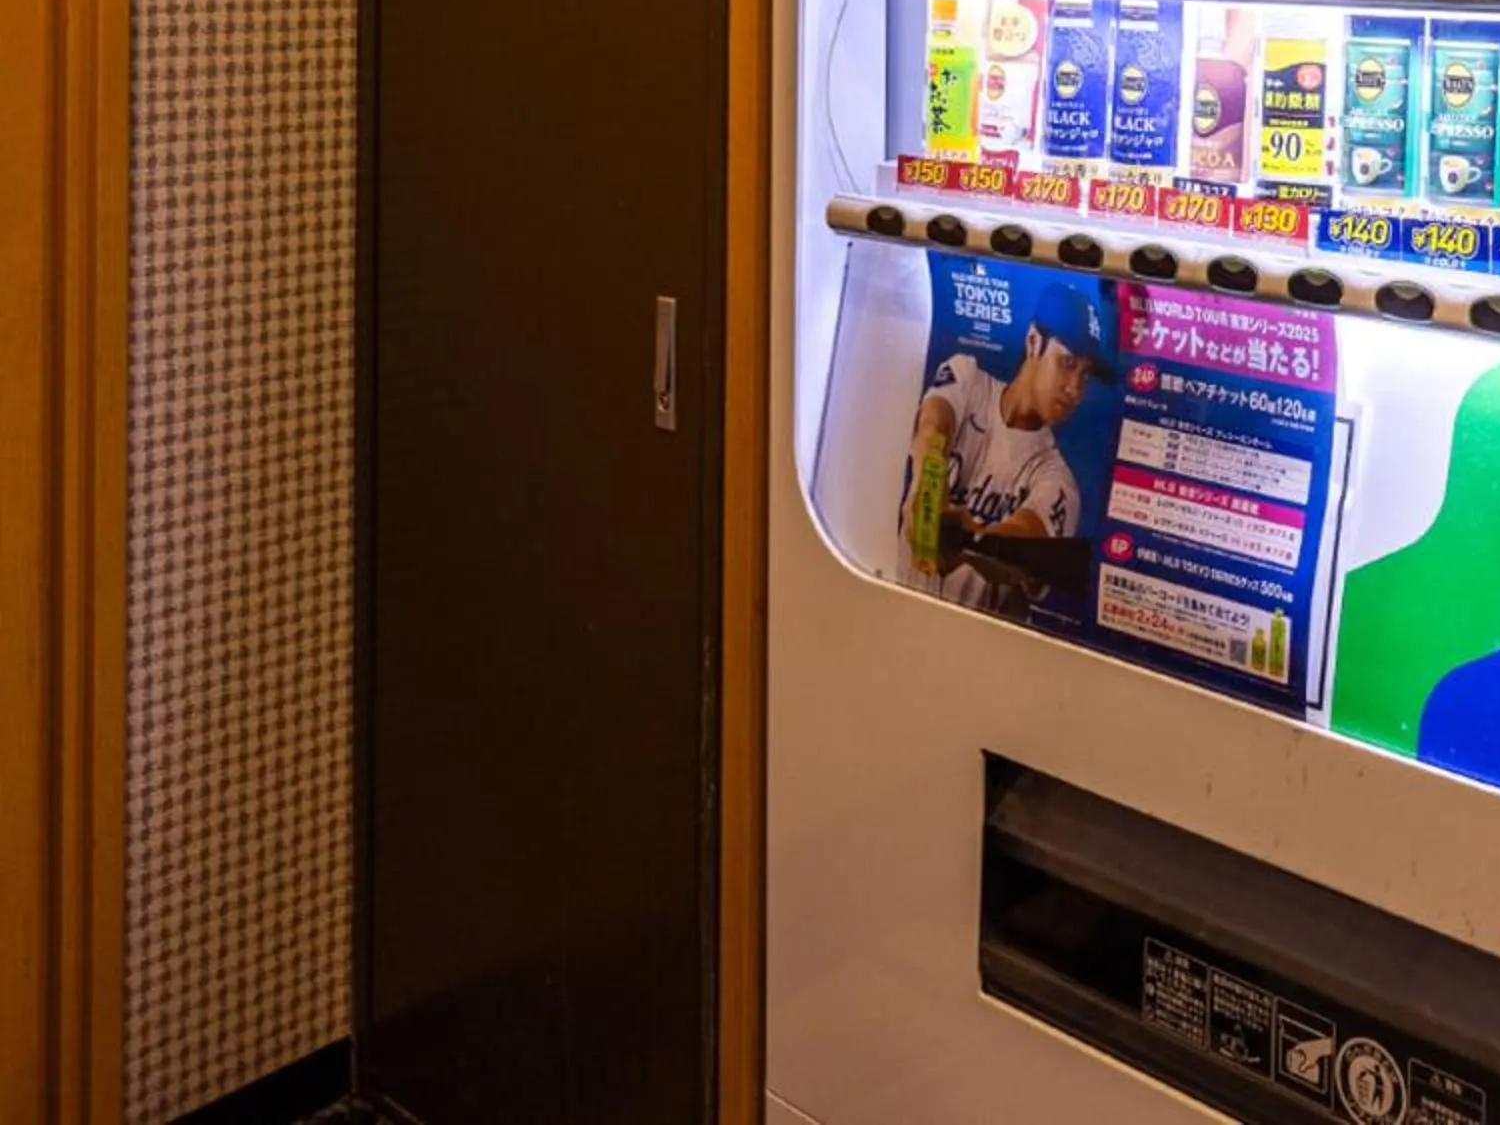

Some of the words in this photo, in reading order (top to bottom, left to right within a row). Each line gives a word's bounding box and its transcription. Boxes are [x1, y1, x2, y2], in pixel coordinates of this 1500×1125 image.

[1096, 186, 1146, 211] ¥170
[1167, 194, 1219, 221] ¥170
[1242, 204, 1297, 232] ¥130
[1329, 216, 1390, 244] ¥140
[1413, 225, 1477, 255] ¥140
[954, 282, 1010, 306] TOKYO
[954, 299, 1013, 325] SERIES
